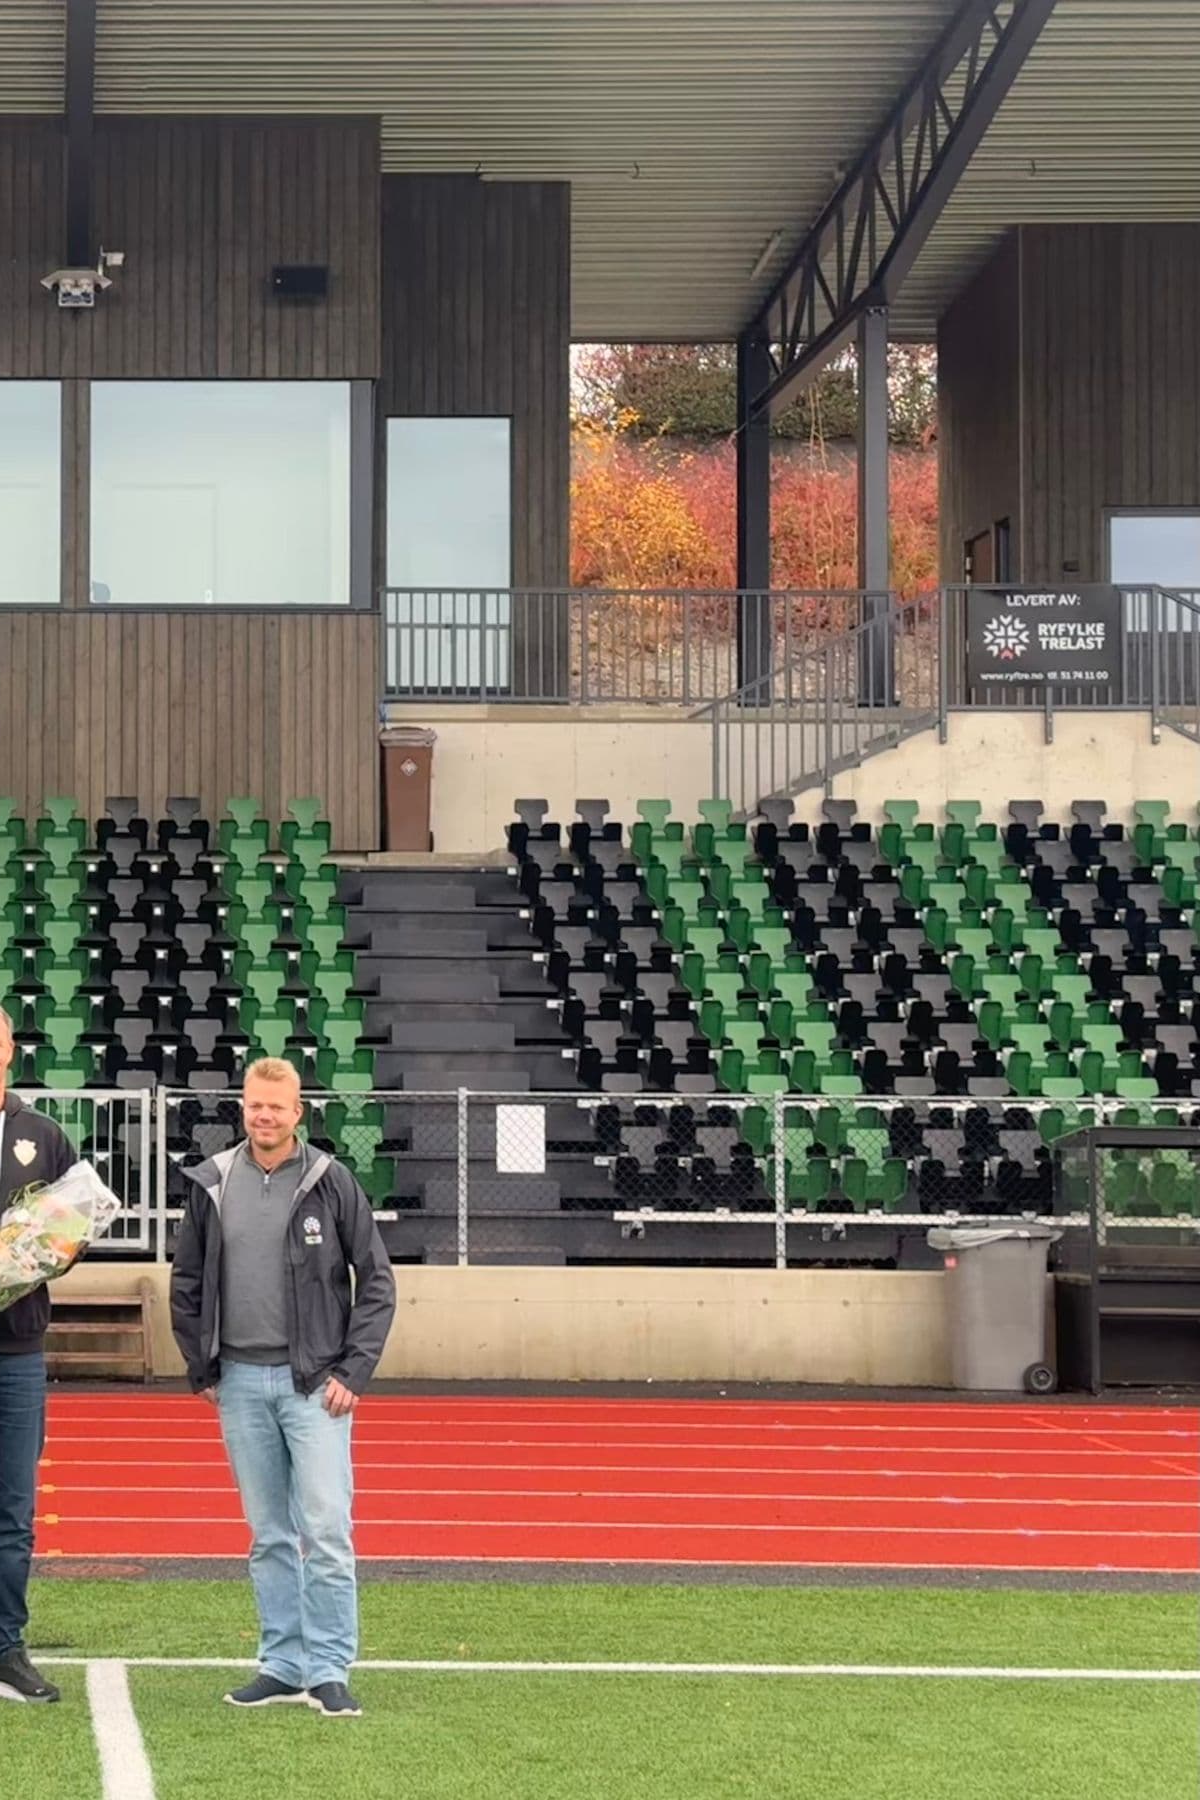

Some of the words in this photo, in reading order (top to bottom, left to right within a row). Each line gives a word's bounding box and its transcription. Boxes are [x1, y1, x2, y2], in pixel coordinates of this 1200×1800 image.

[1006, 594, 1056, 606] LEVERT
[1058, 594, 1081, 606] AV:
[1038, 623, 1105, 636] RYFYLKE
[1039, 637, 1105, 650] TRELAST
[1096, 671, 1109, 680] 00
